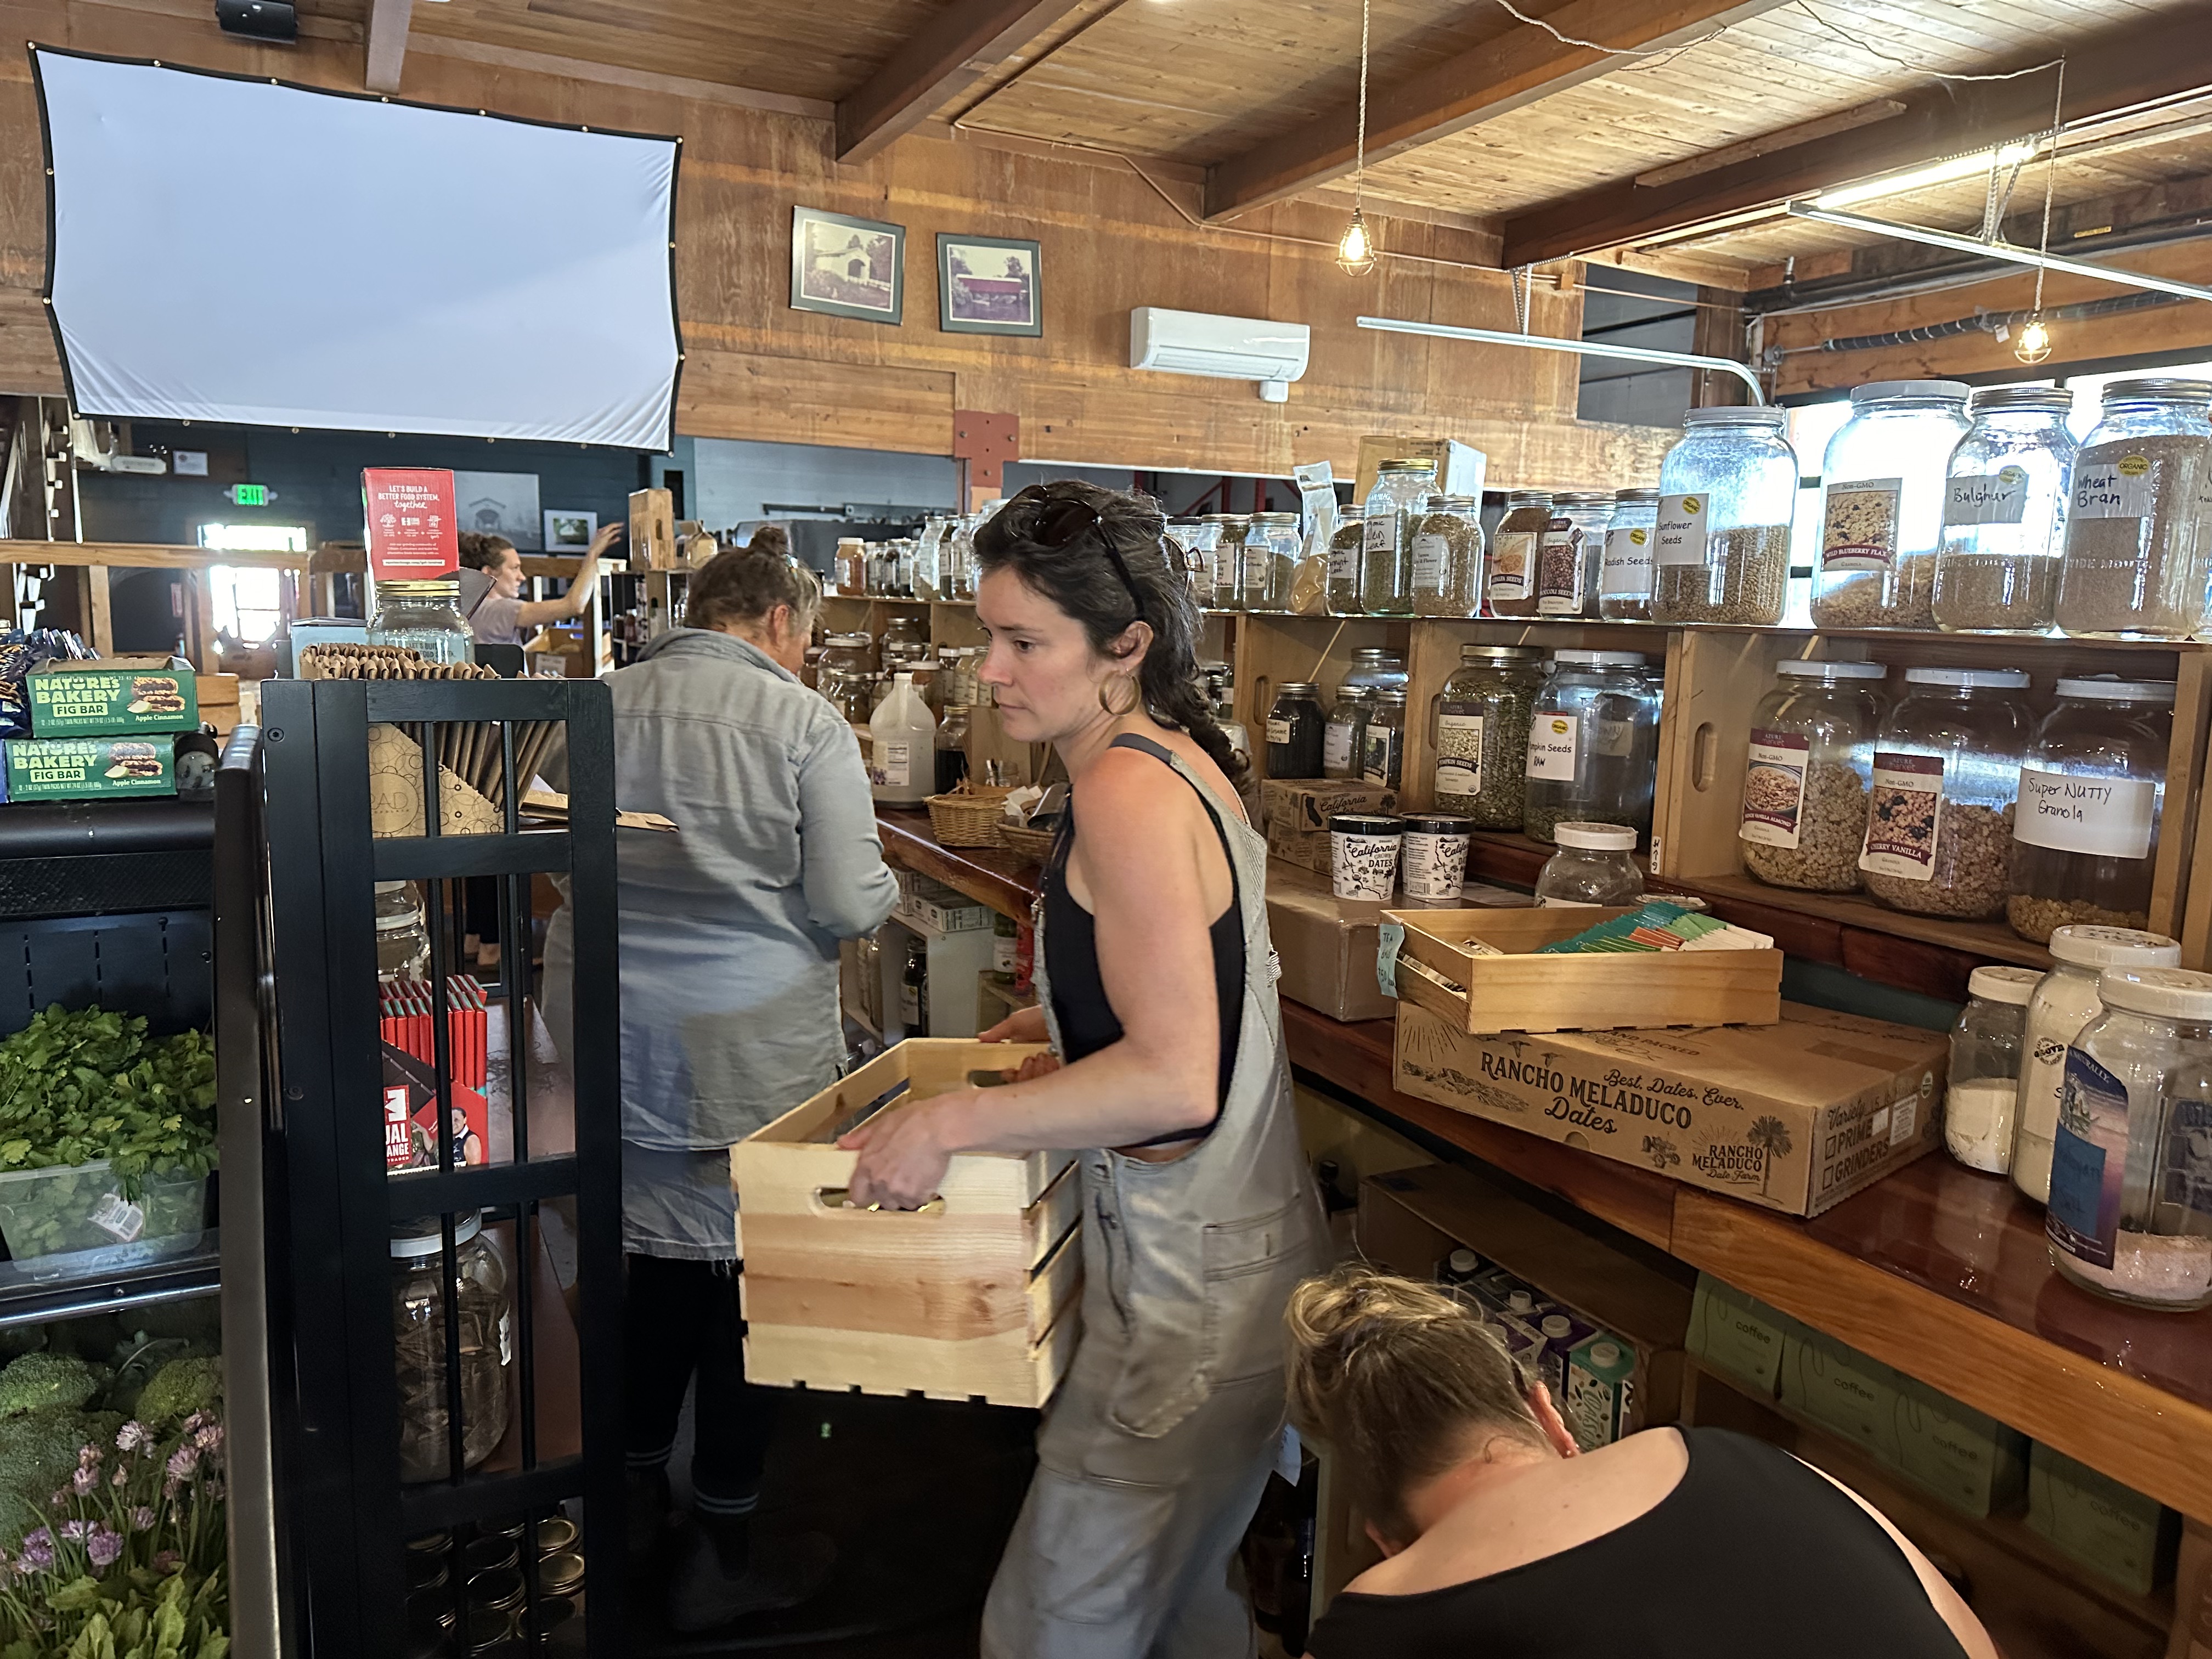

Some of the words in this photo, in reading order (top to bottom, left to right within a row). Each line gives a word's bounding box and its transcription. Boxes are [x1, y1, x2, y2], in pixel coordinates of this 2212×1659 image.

[2119, 462, 2148, 471] ORGANIC
[2078, 474, 2117, 489] Wheat
[238, 485, 263, 504] EXIT
[1953, 483, 2017, 507] Bulghur
[2077, 490, 2120, 507] Bran
[1658, 521, 1692, 531] Sunflower
[1630, 532, 1647, 542] ORGANI
[1661, 535, 1682, 545] Seeds
[1870, 549, 1887, 557] FLAX
[36, 689, 121, 704] BAKERY
[57, 706, 76, 715] FIG
[80, 705, 104, 714] BAR
[1547, 743, 1572, 753] Seeds
[14, 754, 98, 769] BAKERY
[1457, 760, 1472, 768] SEEDS
[1533, 756, 1546, 767] RAW
[34, 771, 54, 780] FIG
[57, 770, 81, 778] BAR
[2028, 777, 2062, 798] Super
[2064, 782, 2112, 805] NUTTY
[1320, 795, 1367, 812] California
[2038, 800, 2083, 823] Granola
[1349, 843, 1397, 857] California
[1891, 844, 1922, 859] VANILLA
[1368, 859, 1393, 868] DATES
[1383, 933, 1393, 943] TEA
[1641, 1039, 1700, 1056] PACKED
[1481, 1052, 1563, 1093] RANCHO
[1570, 1076, 1692, 1129] MELADUCO
[1604, 1069, 1643, 1090] Best.
[1647, 1077, 1699, 1099] Dates.
[1702, 1086, 1744, 1110] Ever.
[1544, 1096, 1618, 1135] Dates
[1828, 1098, 1865, 1131] Variety
[1838, 1117, 1873, 1154] PRIME
[1709, 1145, 1763, 1160] RANCHO
[1835, 1137, 1890, 1182] GRINDERS
[1692, 1154, 1762, 1172] MELADUCO
[1706, 1169, 1730, 1179] Date
[1731, 1170, 1761, 1181] Farm
[1735, 1321, 1771, 1344] coffee
[1834, 1377, 1875, 1401] coffee
[1932, 1435, 1978, 1459] coffee
[2089, 1500, 2140, 1531] coffee
